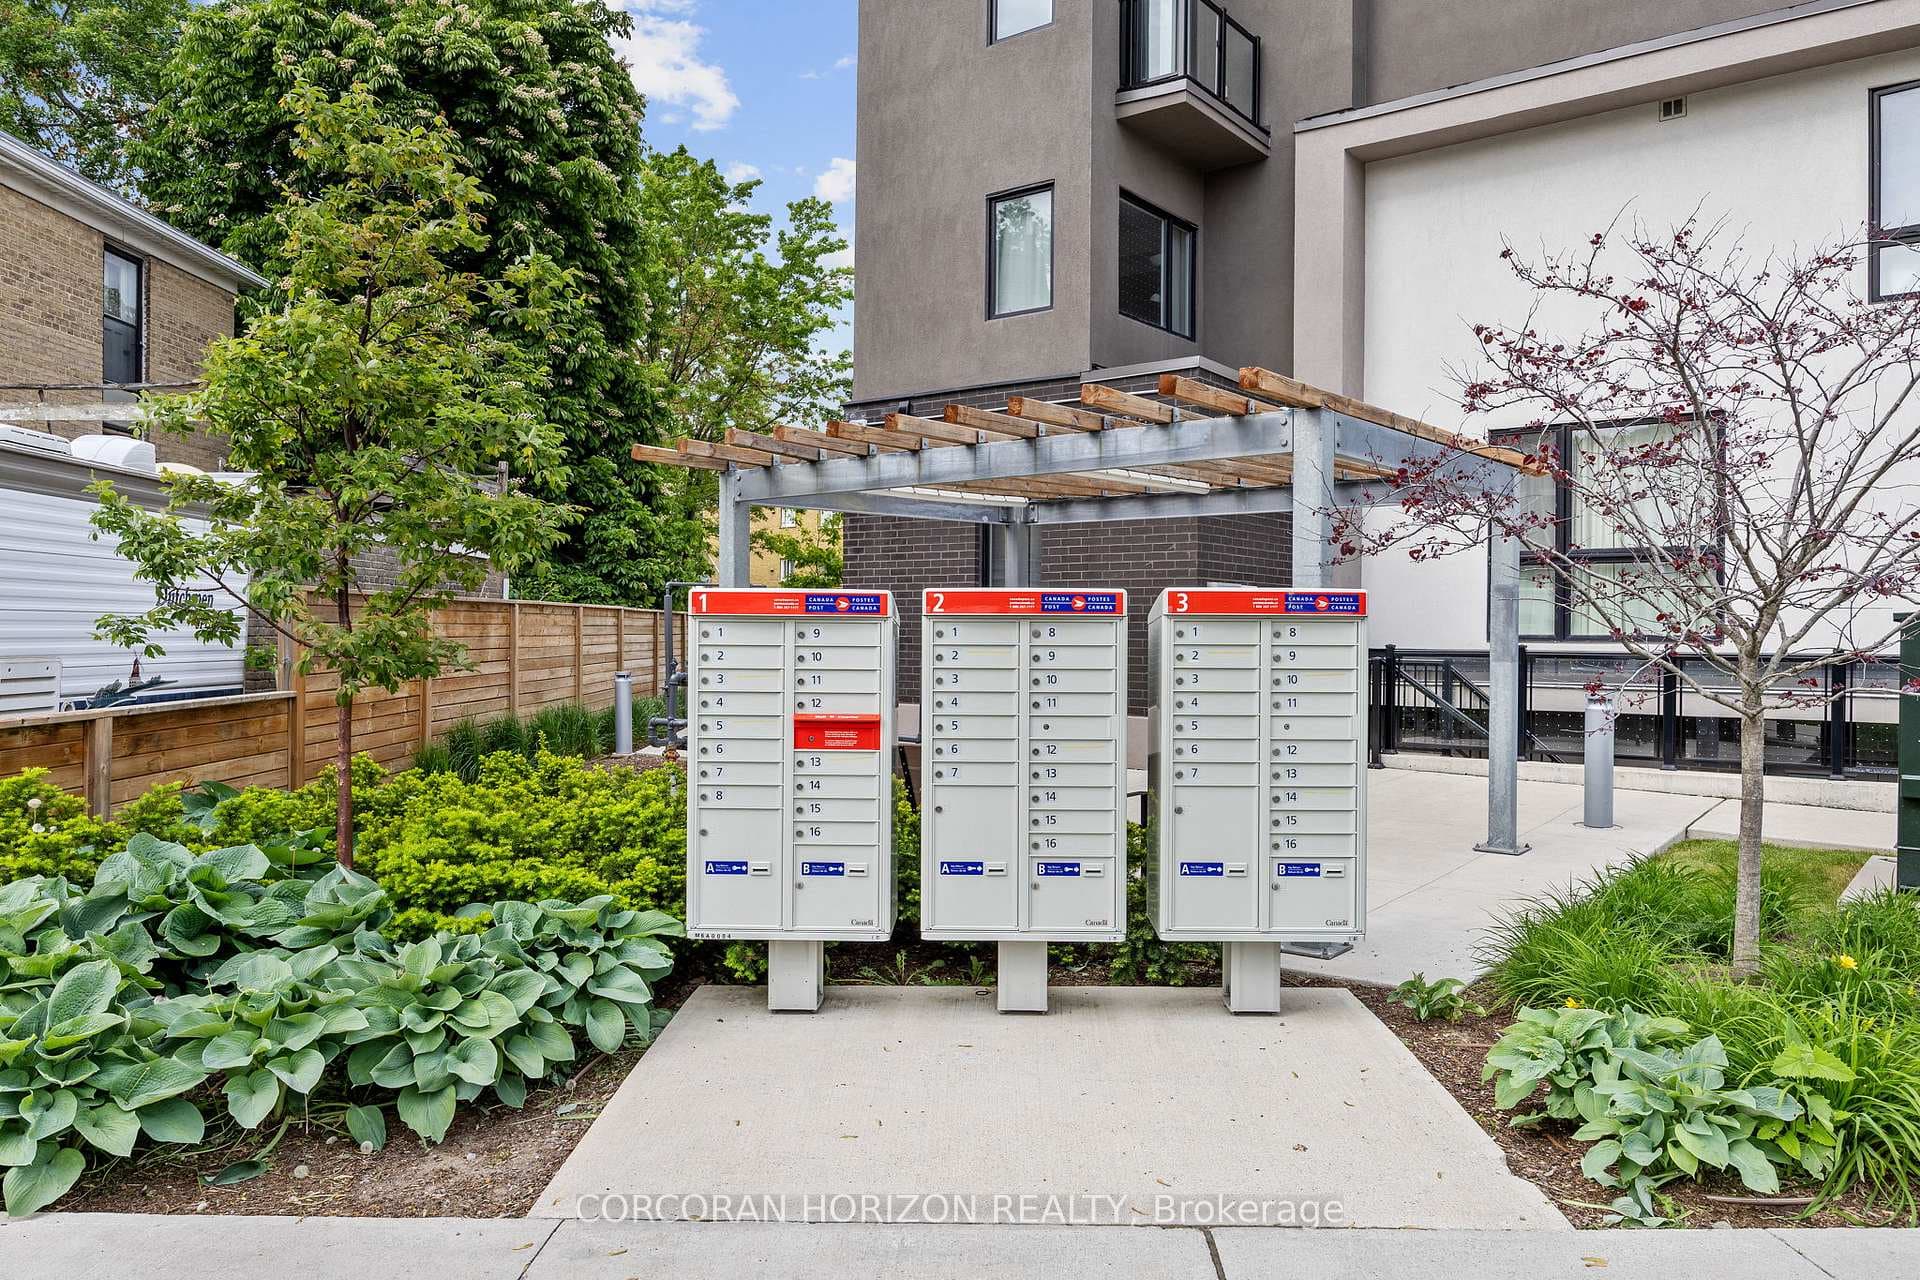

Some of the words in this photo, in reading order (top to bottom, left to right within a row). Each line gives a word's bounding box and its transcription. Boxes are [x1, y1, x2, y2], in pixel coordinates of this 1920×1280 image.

[698, 593, 707, 612] 1
[933, 593, 945, 612] 2
[1176, 593, 1189, 612] 3
[813, 629, 821, 639] 9
[1048, 628, 1056, 638] 8
[1289, 628, 1297, 638] 8
[717, 651, 724, 661] 2
[811, 652, 822, 662] 10
[951, 651, 959, 661] 2
[1048, 651, 1056, 661] 9
[1191, 651, 1199, 661] 2
[1289, 651, 1296, 661] 9
[717, 674, 724, 684] 3
[811, 676, 821, 685] 11
[952, 674, 959, 684] 3
[1046, 675, 1058, 685] 10
[1191, 674, 1199, 684] 3
[1287, 675, 1298, 685] 10
[716, 698, 723, 707] 4
[811, 699, 822, 708] 12
[951, 698, 959, 707] 4
[1047, 698, 1056, 708] 11
[1191, 698, 1198, 707] 4
[1287, 699, 1297, 708] 11
[716, 721, 723, 731] 5
[951, 721, 958, 731] 5
[1191, 721, 1198, 731] 5
[716, 744, 724, 754] 6
[951, 744, 958, 754] 6
[1046, 745, 1057, 755] 12
[1191, 744, 1199, 754] 6
[1286, 745, 1297, 755] 12
[810, 757, 821, 767] 13
[716, 768, 723, 777] 7
[951, 768, 958, 777] 7
[1045, 769, 1057, 778] 13
[1191, 768, 1198, 778] 7
[1285, 769, 1297, 779] 13
[809, 781, 821, 790] 14
[715, 791, 723, 801] 8
[1045, 792, 1057, 801] 14
[1285, 792, 1297, 802] 14
[810, 804, 821, 814] 15
[1045, 816, 1057, 825] 15
[1286, 816, 1297, 825] 15
[809, 827, 821, 837] 16
[1045, 839, 1057, 849] 16
[1285, 839, 1297, 849] 16
[706, 863, 714, 873] A
[803, 864, 810, 874] B
[941, 864, 950, 873] A
[1038, 864, 1045, 874] B
[1181, 864, 1189, 874] A
[1279, 864, 1286, 875] B
